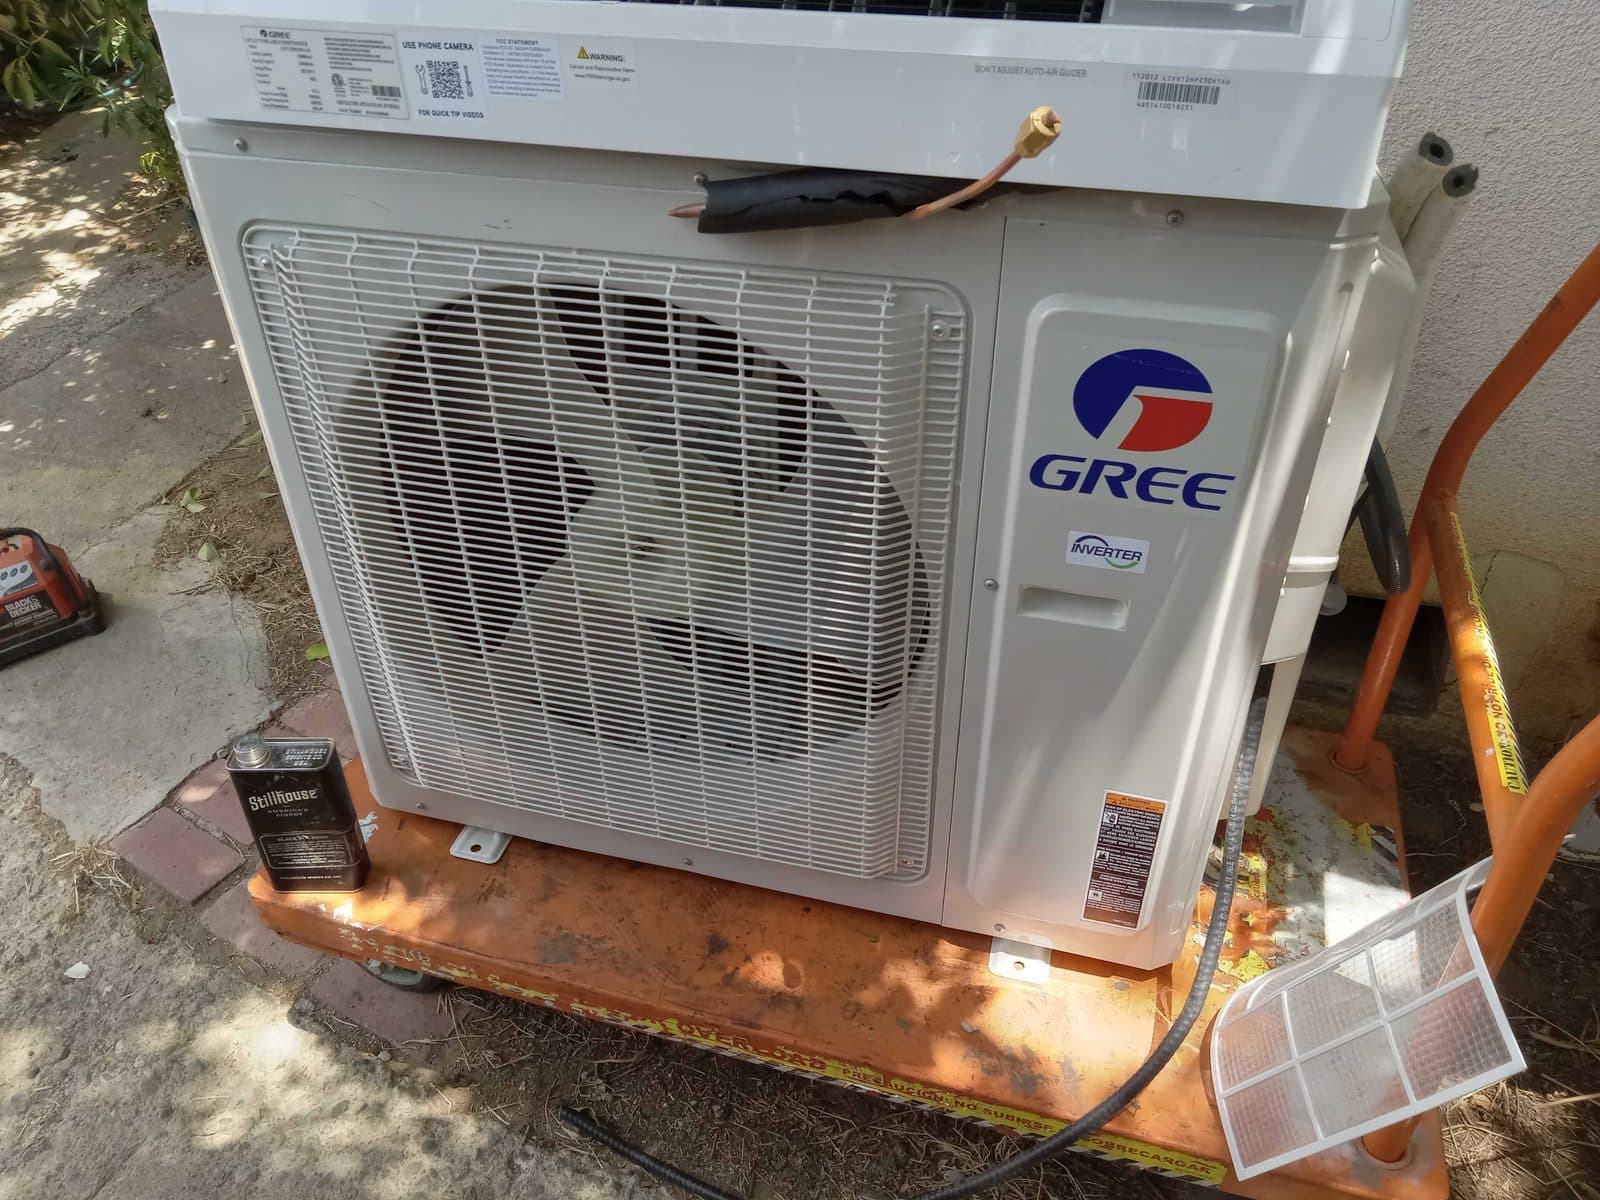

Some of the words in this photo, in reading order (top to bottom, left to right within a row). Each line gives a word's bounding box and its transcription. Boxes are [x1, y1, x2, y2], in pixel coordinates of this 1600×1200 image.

[268, 31, 291, 40] GREE
[401, 41, 416, 49] USE
[417, 41, 442, 50] PHONE
[443, 42, 474, 51] CAMERA
[997, 65, 1024, 75] ADJUST
[462, 111, 484, 119] VIDEOS
[1029, 453, 1236, 511] GREE
[1070, 543, 1143, 562] INVERTER
[10, 602, 42, 619] DECKER
[1490, 699, 1503, 719] NOT
[248, 788, 318, 811] Stillhouse
[954, 1100, 977, 1111] NO
[1081, 1135, 1214, 1175] SOBRECARGAR
